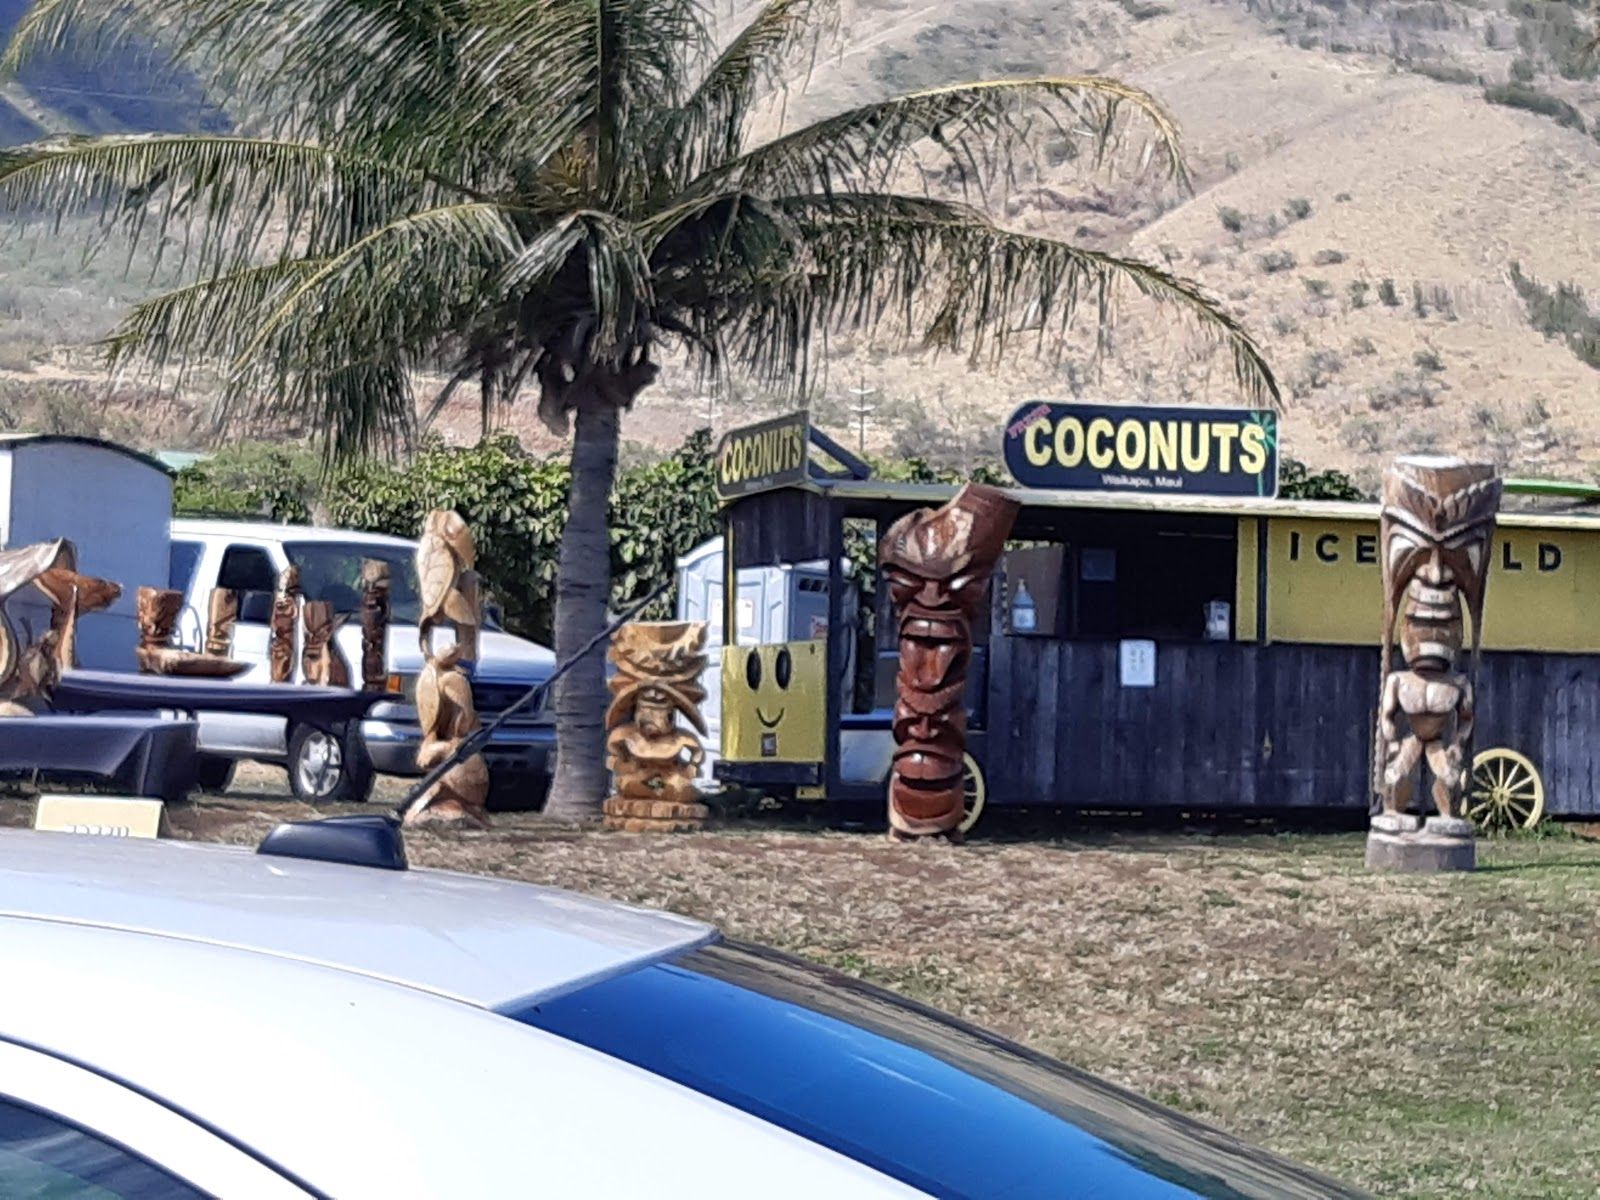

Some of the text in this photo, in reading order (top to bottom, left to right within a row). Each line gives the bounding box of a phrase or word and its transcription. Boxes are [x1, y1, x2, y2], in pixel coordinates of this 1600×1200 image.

[721, 424, 801, 485] COCONUTS
[1024, 416, 1266, 474] COCONUTS
[1155, 476, 1183, 488] Maui
[1289, 532, 1562, 571] ICE LD
